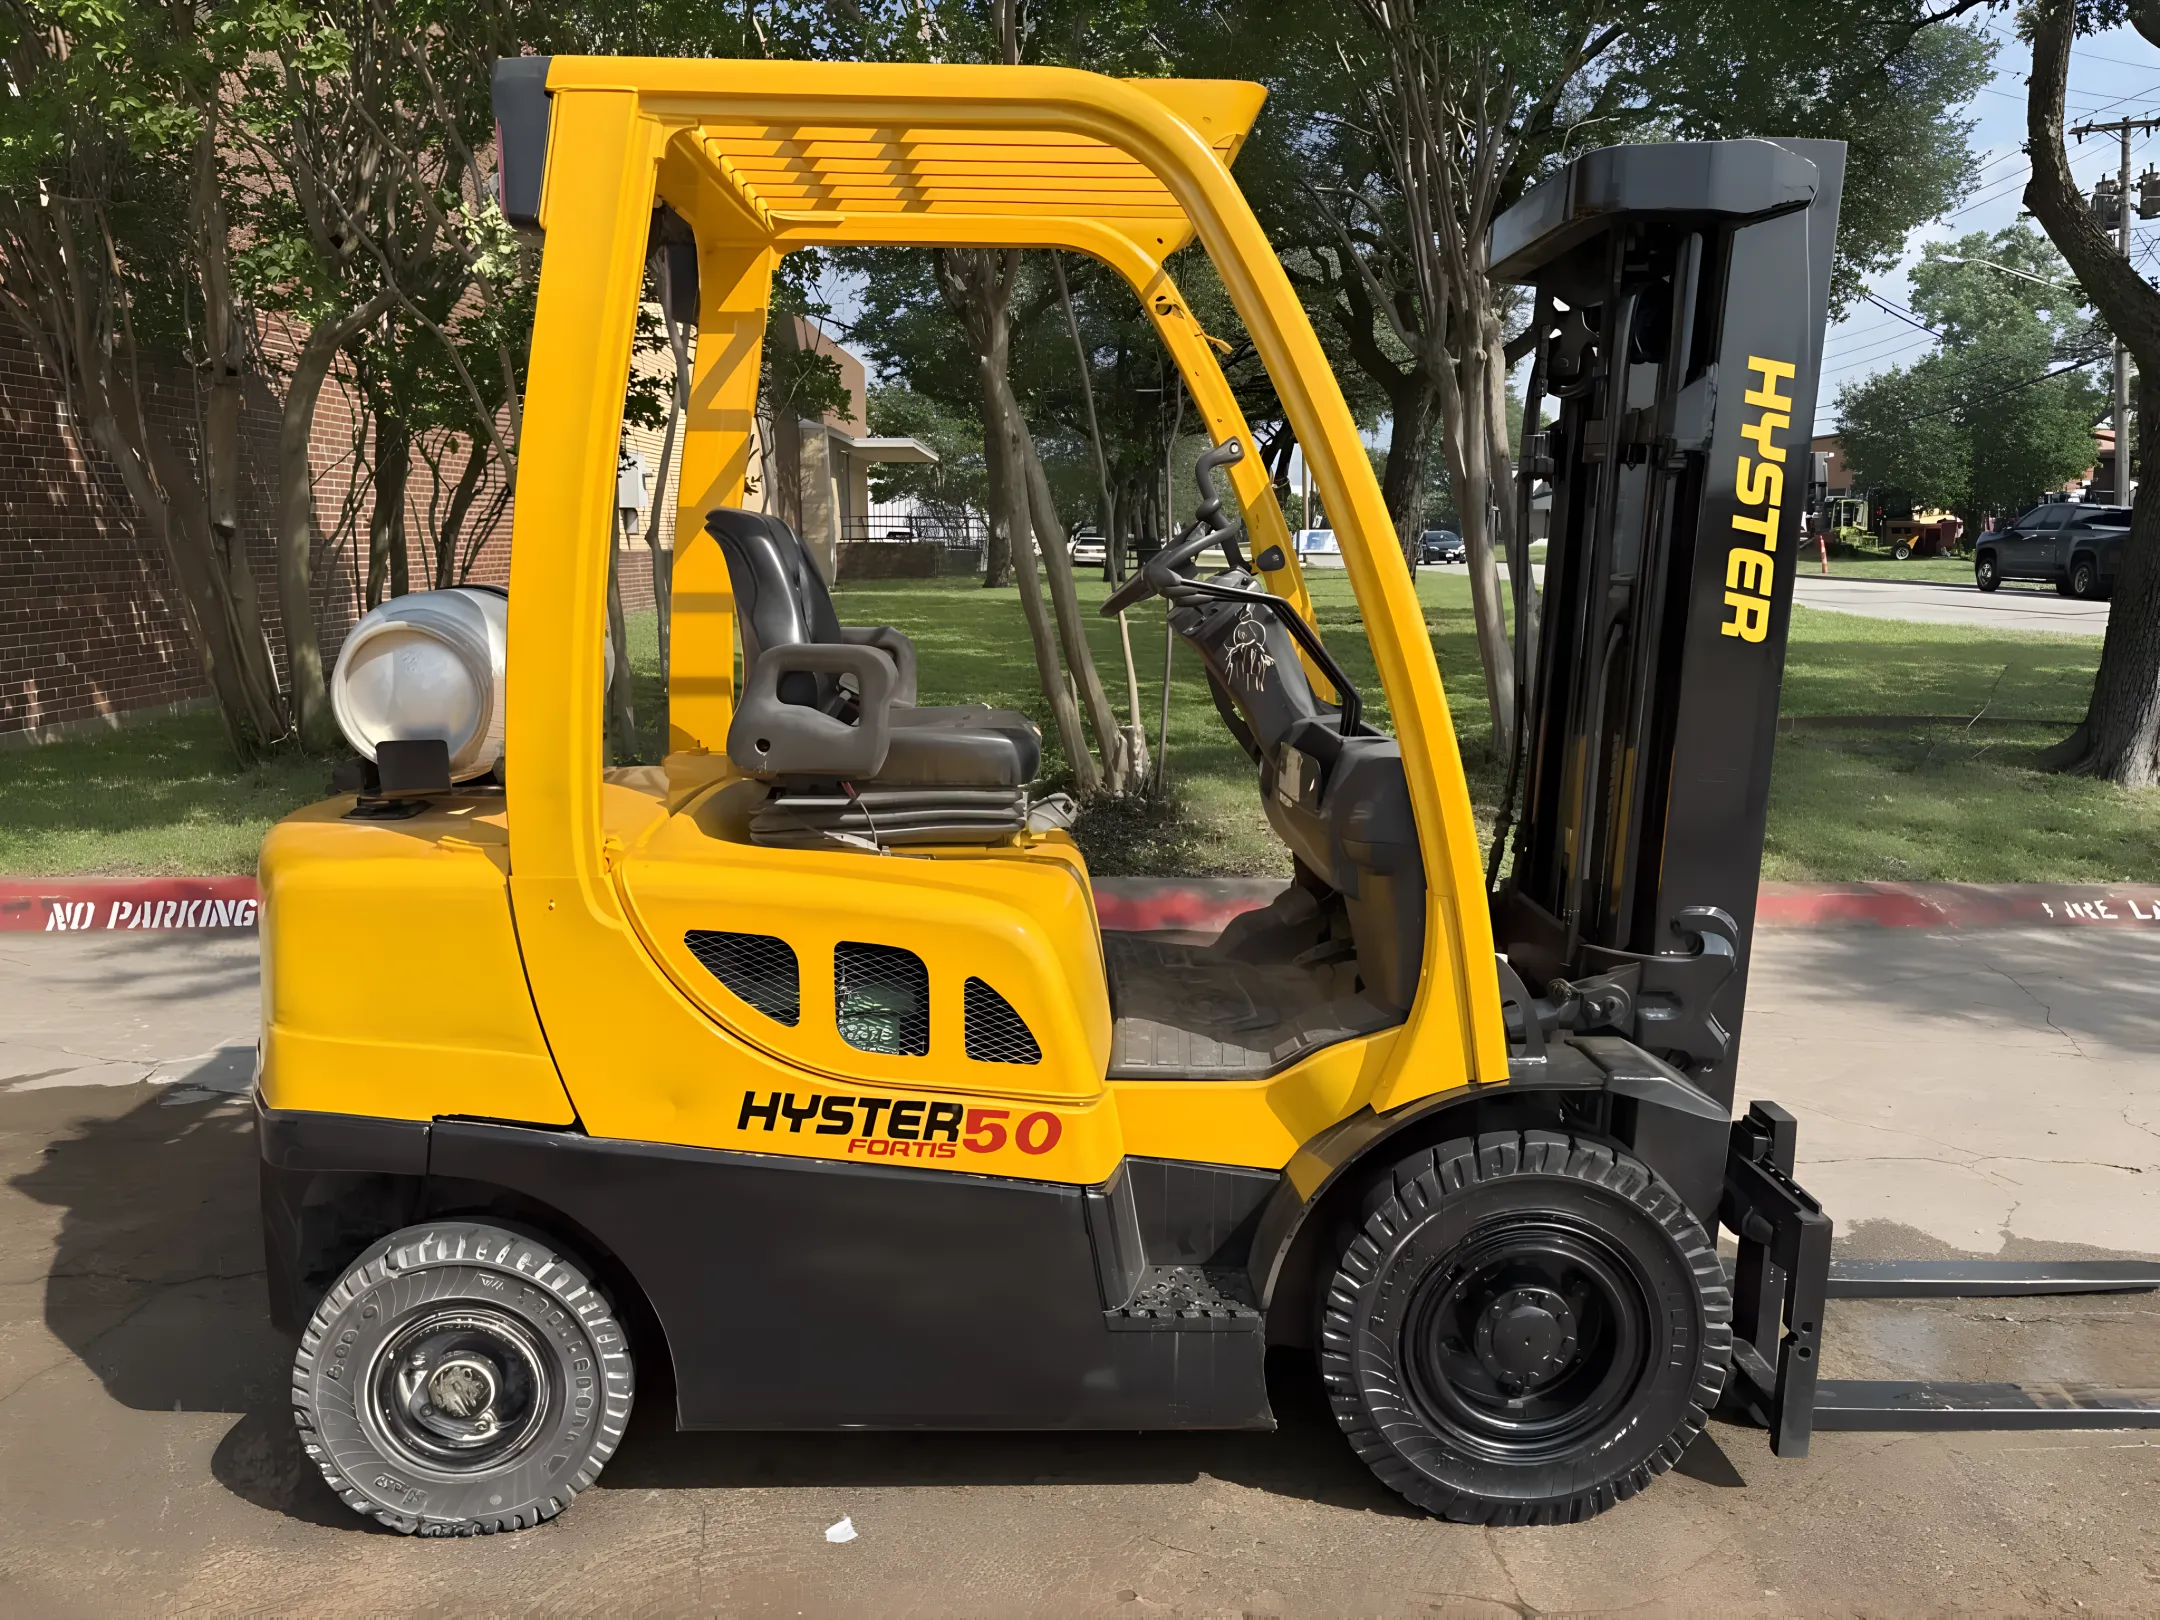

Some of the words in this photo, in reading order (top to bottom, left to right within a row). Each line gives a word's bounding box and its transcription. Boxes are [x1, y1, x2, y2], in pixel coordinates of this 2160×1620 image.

[1721, 355, 1796, 643] HYSTER
[45, 901, 95, 931] NO
[106, 899, 258, 929] PARKING
[737, 1090, 964, 1143] HYSTER
[962, 1108, 1063, 1155] 50
[847, 1138, 957, 1159] FORTIS
